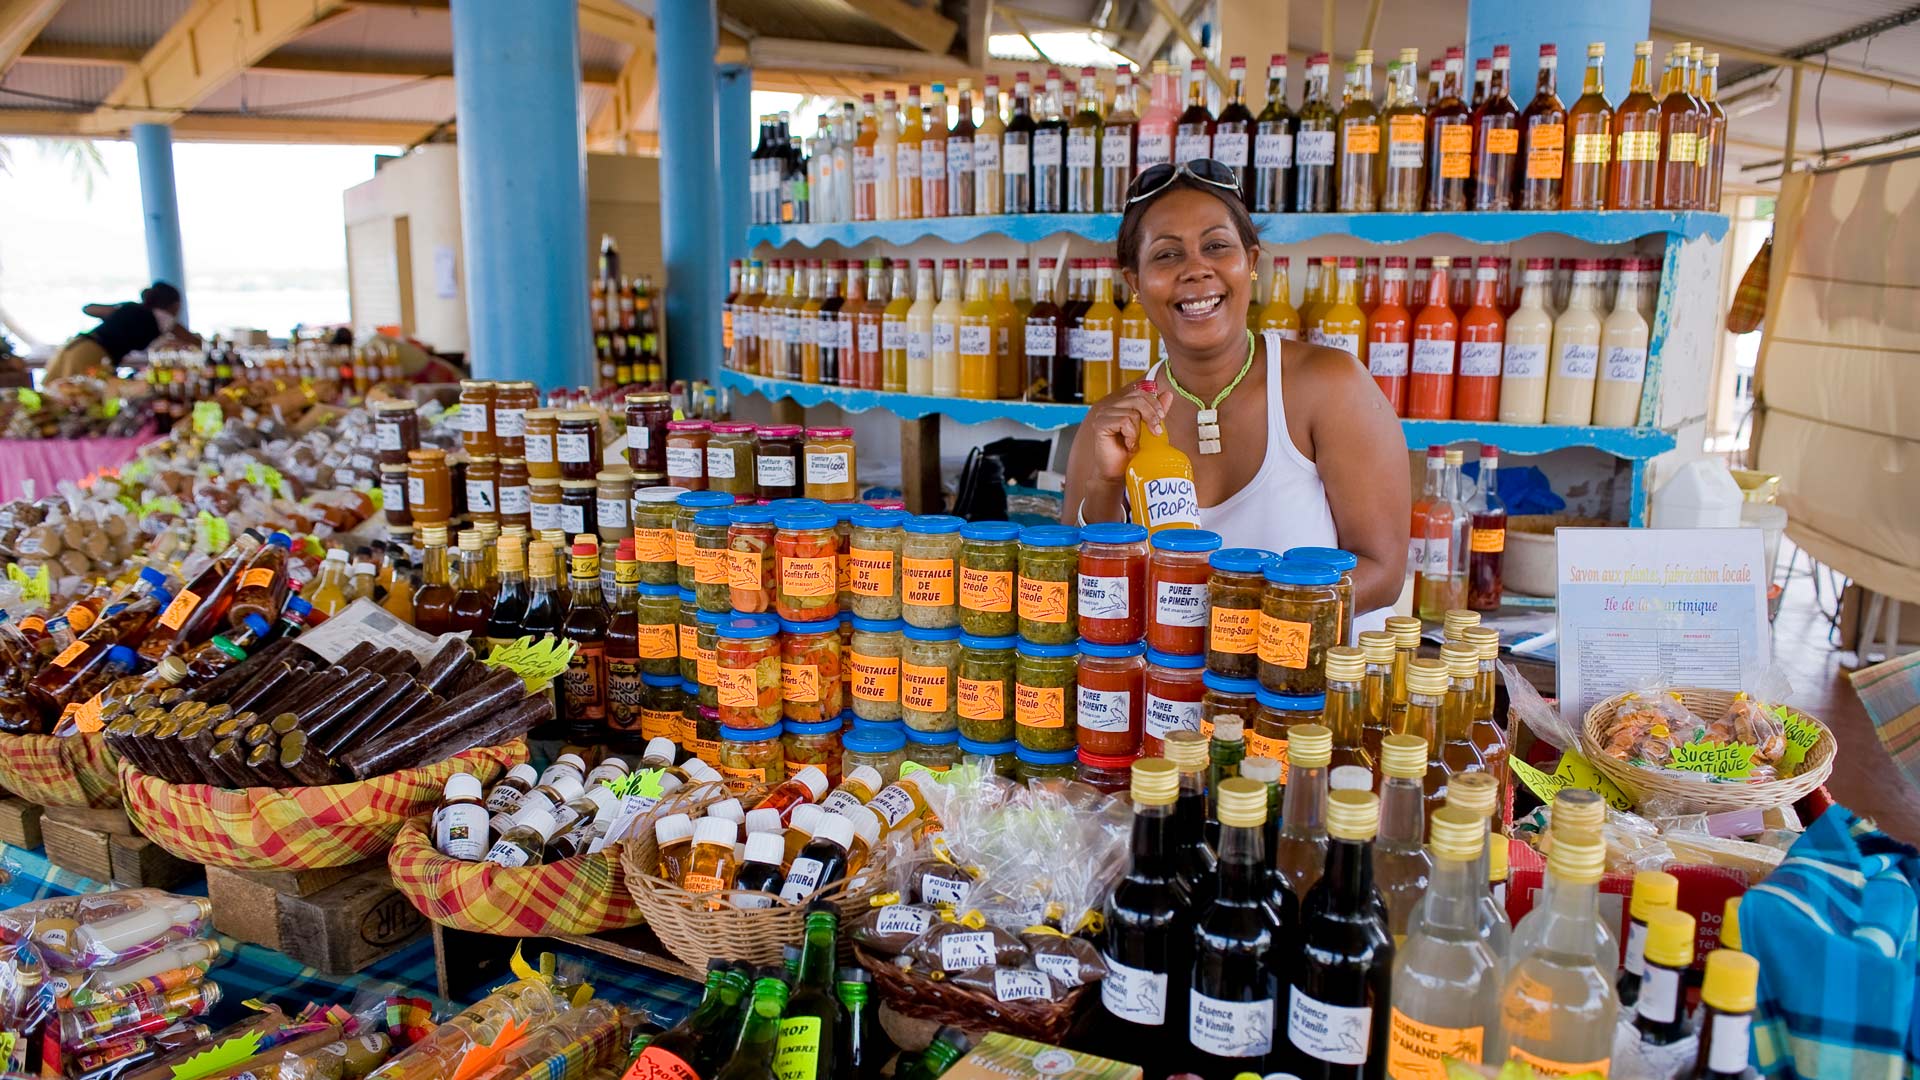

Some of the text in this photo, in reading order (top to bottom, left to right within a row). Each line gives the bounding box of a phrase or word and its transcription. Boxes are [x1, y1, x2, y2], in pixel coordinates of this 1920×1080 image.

[1148, 479, 1192, 499] PUNCH
[790, 561, 814, 571] Piments
[804, 570, 820, 580] Forts
[859, 570, 870, 580] DE
[963, 570, 989, 583] Sauce
[1570, 565, 1599, 583] Savon
[1602, 570, 1620, 582] aux
[1662, 563, 1719, 588] fabrication
[1722, 563, 1752, 583] locale
[852, 579, 879, 592] MORUE
[918, 581, 930, 591] DE
[1020, 578, 1043, 593] Sauce
[1081, 577, 1099, 588] PUREE
[908, 591, 941, 602] MORUE
[1081, 588, 1106, 599] PIMENTS
[1168, 585, 1193, 596] PUREE
[1159, 595, 1199, 607] de PIMENTS
[1604, 597, 1619, 611] Ile
[1621, 596, 1635, 611] de
[1638, 596, 1649, 611] la
[1219, 612, 1250, 625] Confit de
[645, 625, 660, 634] chien
[1271, 624, 1280, 634] de
[784, 676, 798, 685] Forts
[863, 676, 876, 686] DE
[958, 679, 978, 692] Sauce
[855, 685, 885, 698] MORUE
[911, 686, 923, 696] DE
[1017, 685, 1039, 699] Sauce
[1083, 690, 1101, 702] PUREE
[904, 694, 933, 708] MORUE
[1082, 700, 1108, 713] PIMENTS
[1152, 699, 1174, 713] PUREE
[1151, 710, 1180, 725] PIMENTS
[705, 741, 718, 750] chien
[883, 792, 894, 801] DE
[834, 800, 846, 810] DE
[929, 879, 962, 890] POUDRE
[880, 920, 922, 934] VANILLE
[947, 934, 985, 944] POUDRE
[947, 955, 989, 969] VANILLE
[1000, 986, 1046, 1000] VANILLE
[1198, 1000, 1233, 1020] Essence
[1296, 997, 1329, 1021] Essence
[1204, 1017, 1235, 1034] Vanille
[1301, 1016, 1329, 1036] Vanille
